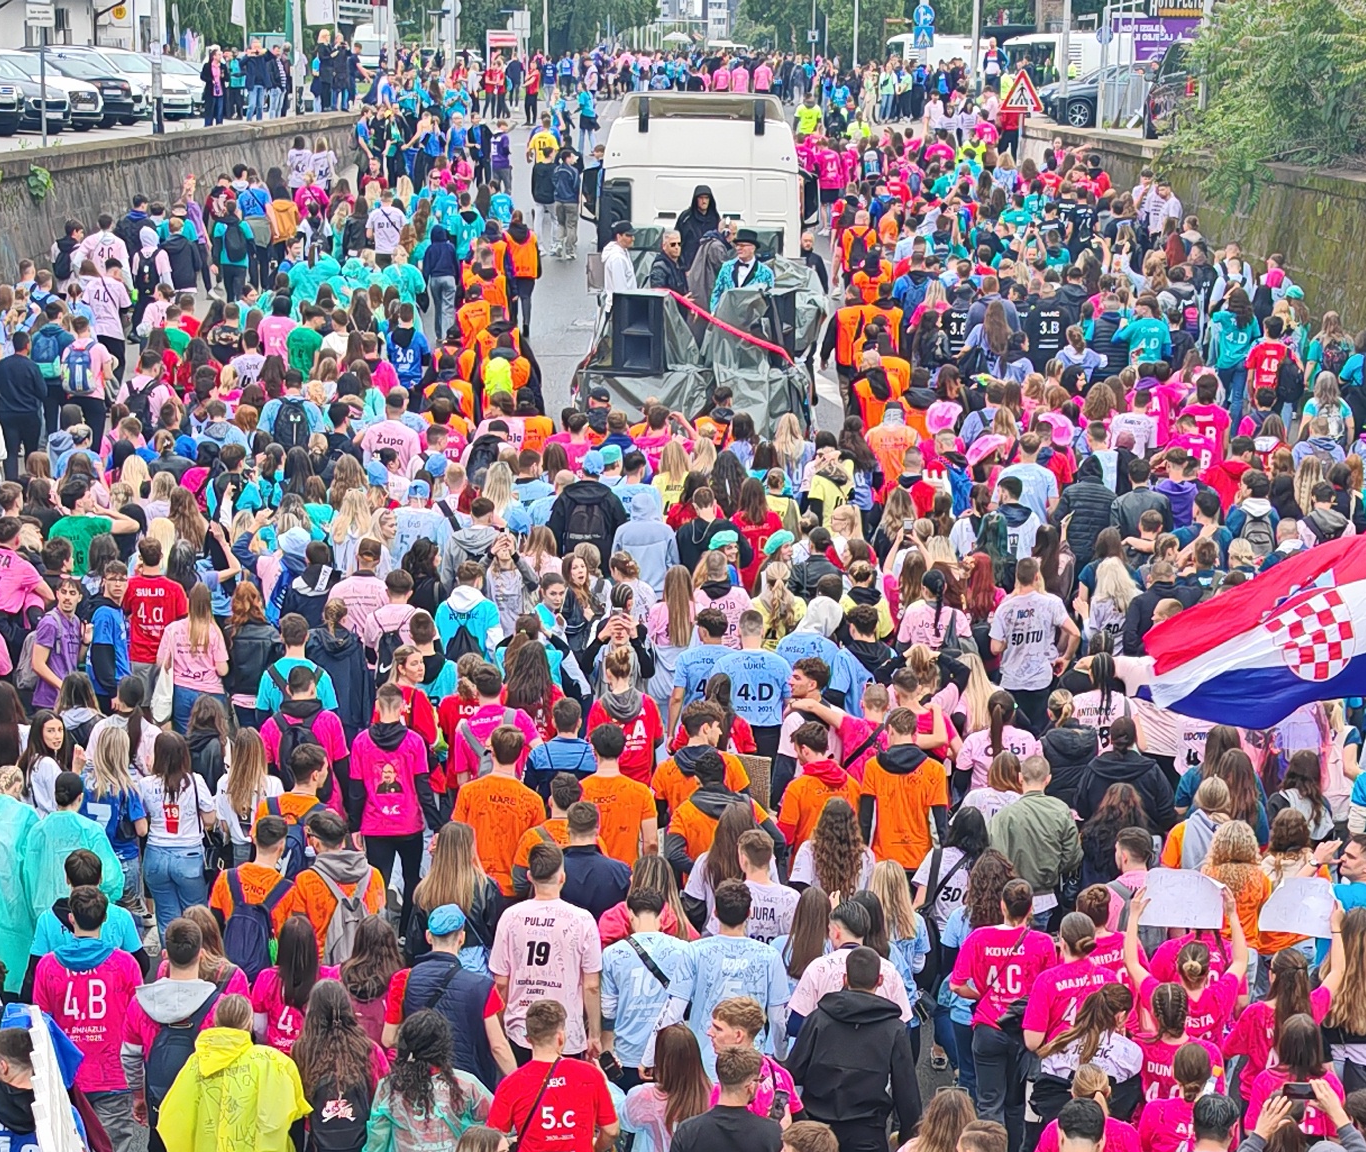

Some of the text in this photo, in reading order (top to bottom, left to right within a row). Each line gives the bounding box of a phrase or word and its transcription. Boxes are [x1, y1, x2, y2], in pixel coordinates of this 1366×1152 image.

[1039, 320, 1061, 336] 3.B
[1226, 332, 1247, 345] 4.D
[1262, 357, 1279, 373] 4.B
[377, 432, 404, 447] Župa
[136, 586, 164, 597] SULJO
[742, 660, 767, 670] LUKIĆ
[737, 682, 774, 701] 4.D
[164, 806, 179, 818] 19
[524, 915, 557, 928] PULJIZ
[526, 940, 551, 967] 19
[723, 957, 749, 970] BOBO
[987, 964, 1022, 995] 4.C
[63, 977, 108, 1019] 4.B
